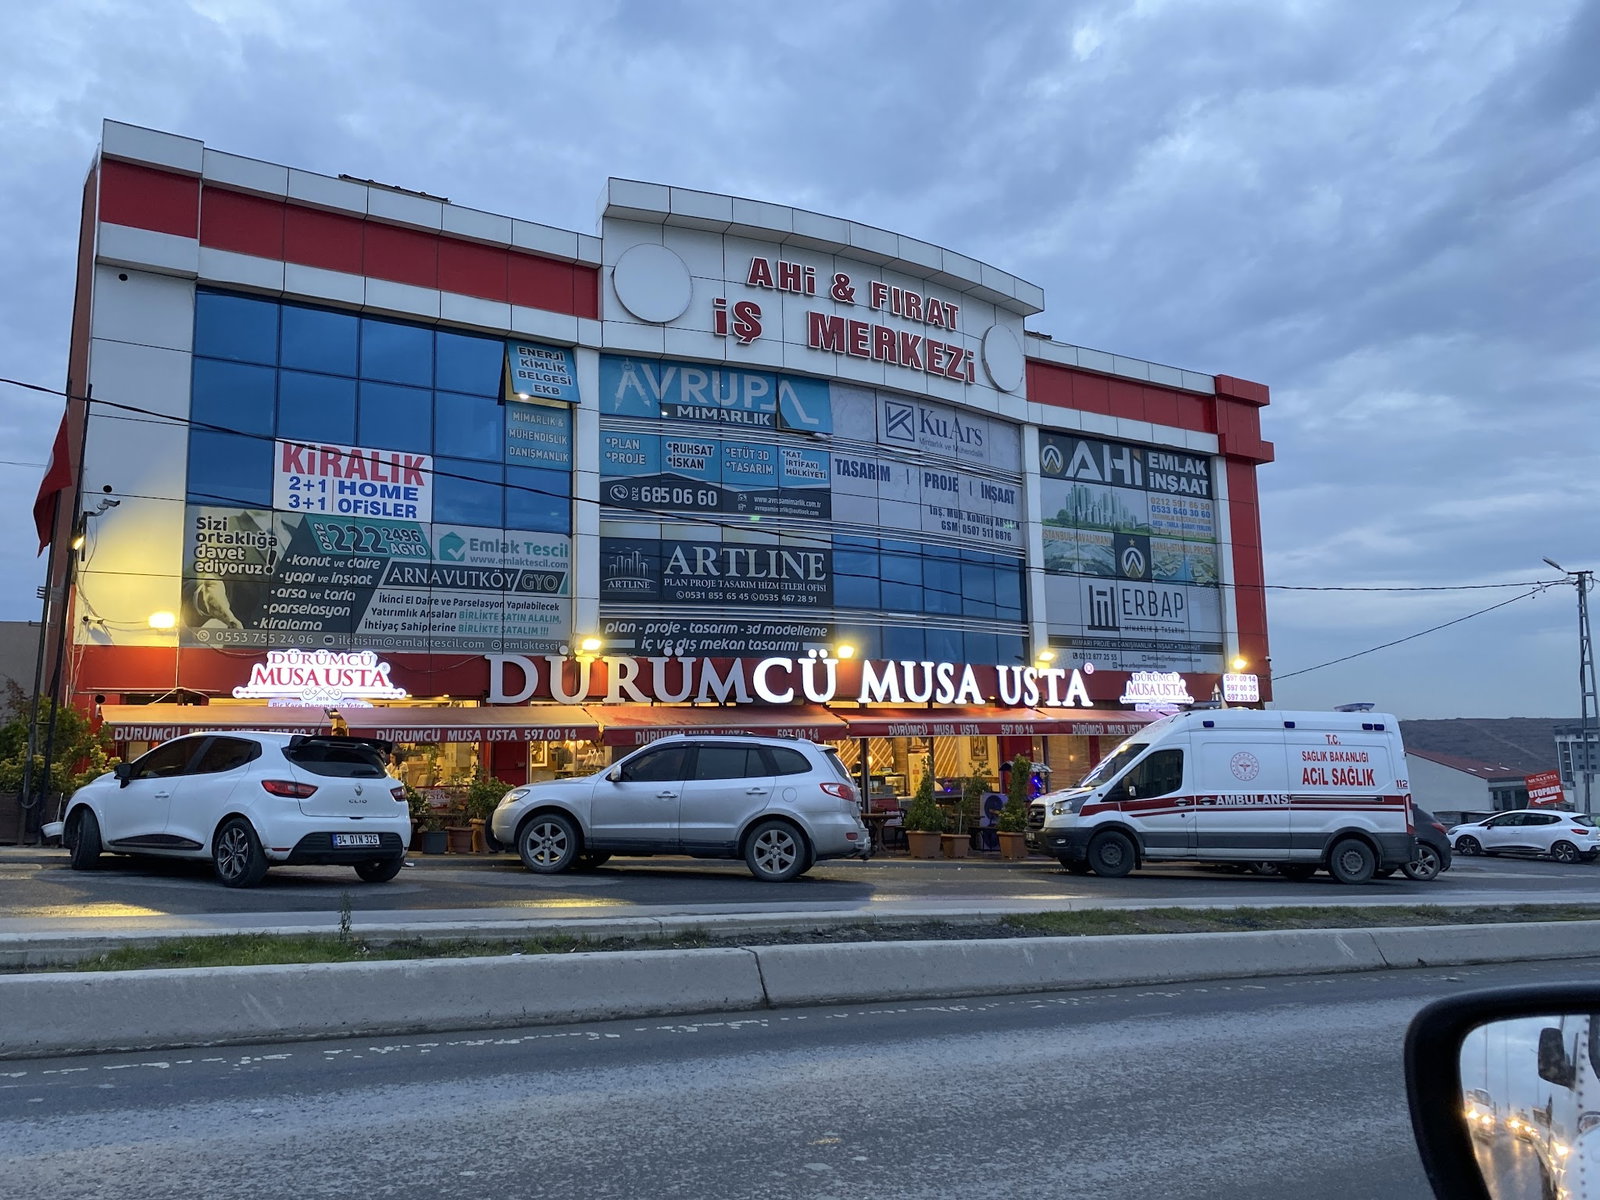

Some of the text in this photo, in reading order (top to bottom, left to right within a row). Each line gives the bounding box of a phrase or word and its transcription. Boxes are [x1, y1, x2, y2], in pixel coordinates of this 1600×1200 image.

[831, 272, 856, 304] &
[869, 280, 959, 331] FIRAT
[518, 347, 564, 361] ENERJİ
[520, 358, 566, 373] KİMLİK
[518, 370, 572, 386] BELGESİ
[534, 384, 560, 395] EKB
[614, 358, 819, 425] AVRUPA
[919, 408, 983, 447] KuArs
[509, 446, 569, 462] DANIŞMANLIK
[757, 451, 769, 461] 3D
[1148, 452, 1207, 476] EMLAK
[288, 476, 419, 501] 2+1 HOME
[835, 458, 1015, 505] TASARIM PROJE İNŞAAT
[288, 494, 326, 511] 3+1
[641, 487, 717, 506] 685 06 60
[1151, 505, 1211, 518] 0533 640 30 60
[196, 516, 228, 531] Sizi
[195, 531, 278, 549] ortaklığa
[313, 522, 332, 551] 0212
[326, 524, 388, 553] 222
[382, 527, 421, 543] 2496
[194, 544, 246, 561] davet
[389, 543, 427, 557] AGYO
[470, 538, 568, 558] Emlak Tescil
[291, 554, 380, 570] konut ve daire
[470, 555, 568, 569] www.emlaktescil.com
[664, 545, 827, 581] ARTLINE
[284, 571, 373, 586] yapı ve inşaat
[389, 567, 558, 591] ARNAVUTKÖY GYO
[608, 581, 651, 589] ARTLINE
[664, 578, 688, 587] PLAN
[690, 579, 716, 588] PROJE
[718, 580, 756, 589] TASARIM
[276, 588, 355, 601] arsa ve tarla
[379, 594, 403, 604] İkinci
[405, 596, 414, 604] El
[416, 597, 439, 606] Daire
[453, 598, 504, 610] Parselasyon
[506, 600, 560, 611] Yapılabilecek
[685, 591, 817, 603] 0531 855 65 45 0535 467 28 91
[268, 603, 350, 619] parselasyon
[1122, 588, 1184, 619] ERBAP
[371, 607, 418, 618] Yatırımlık
[420, 609, 457, 619] Arsaları
[501, 612, 526, 622] SATIN
[259, 617, 323, 631] kiralama
[364, 618, 399, 632] İhtiyaç
[401, 621, 456, 633] Sahiplerine
[501, 625, 538, 635] SATALIM
[605, 621, 828, 637] plan proje tasarım 3d modelleme
[215, 631, 248, 642] 0553
[252, 632, 276, 644] 755
[280, 634, 295, 644] 24
[298, 634, 314, 645] 96
[338, 634, 485, 650] iletisim@emlaktescil.com
[641, 636, 799, 652] iç ve dış mekan tasarımı
[1094, 640, 1111, 648] PROJE
[271, 650, 372, 666] DÜRÜMCÜ
[253, 667, 388, 687] MUSA USTA
[485, 646, 1094, 708] DÜRÜMCÜ MUSA USTA
[1128, 683, 1185, 696] MUSA USTA
[1227, 684, 1247, 692] 597 00
[447, 729, 577, 741] MUSA USTA 597 00 14
[933, 725, 954, 735] MUSA
[960, 725, 979, 735] USTA
[1001, 725, 1014, 735] 597
[1015, 725, 1024, 735] 00
[1026, 725, 1034, 735] 14
[1107, 724, 1125, 734] MUSA
[1325, 734, 1341, 745] T.C.
[1302, 749, 1328, 762] SAĞLIK
[1332, 766, 1375, 786] SAĞLIK
[1396, 780, 1408, 788] 112
[1216, 794, 1289, 805] AMBULANS
[1529, 785, 1561, 798] OTOPARK
[337, 835, 346, 844] 34
